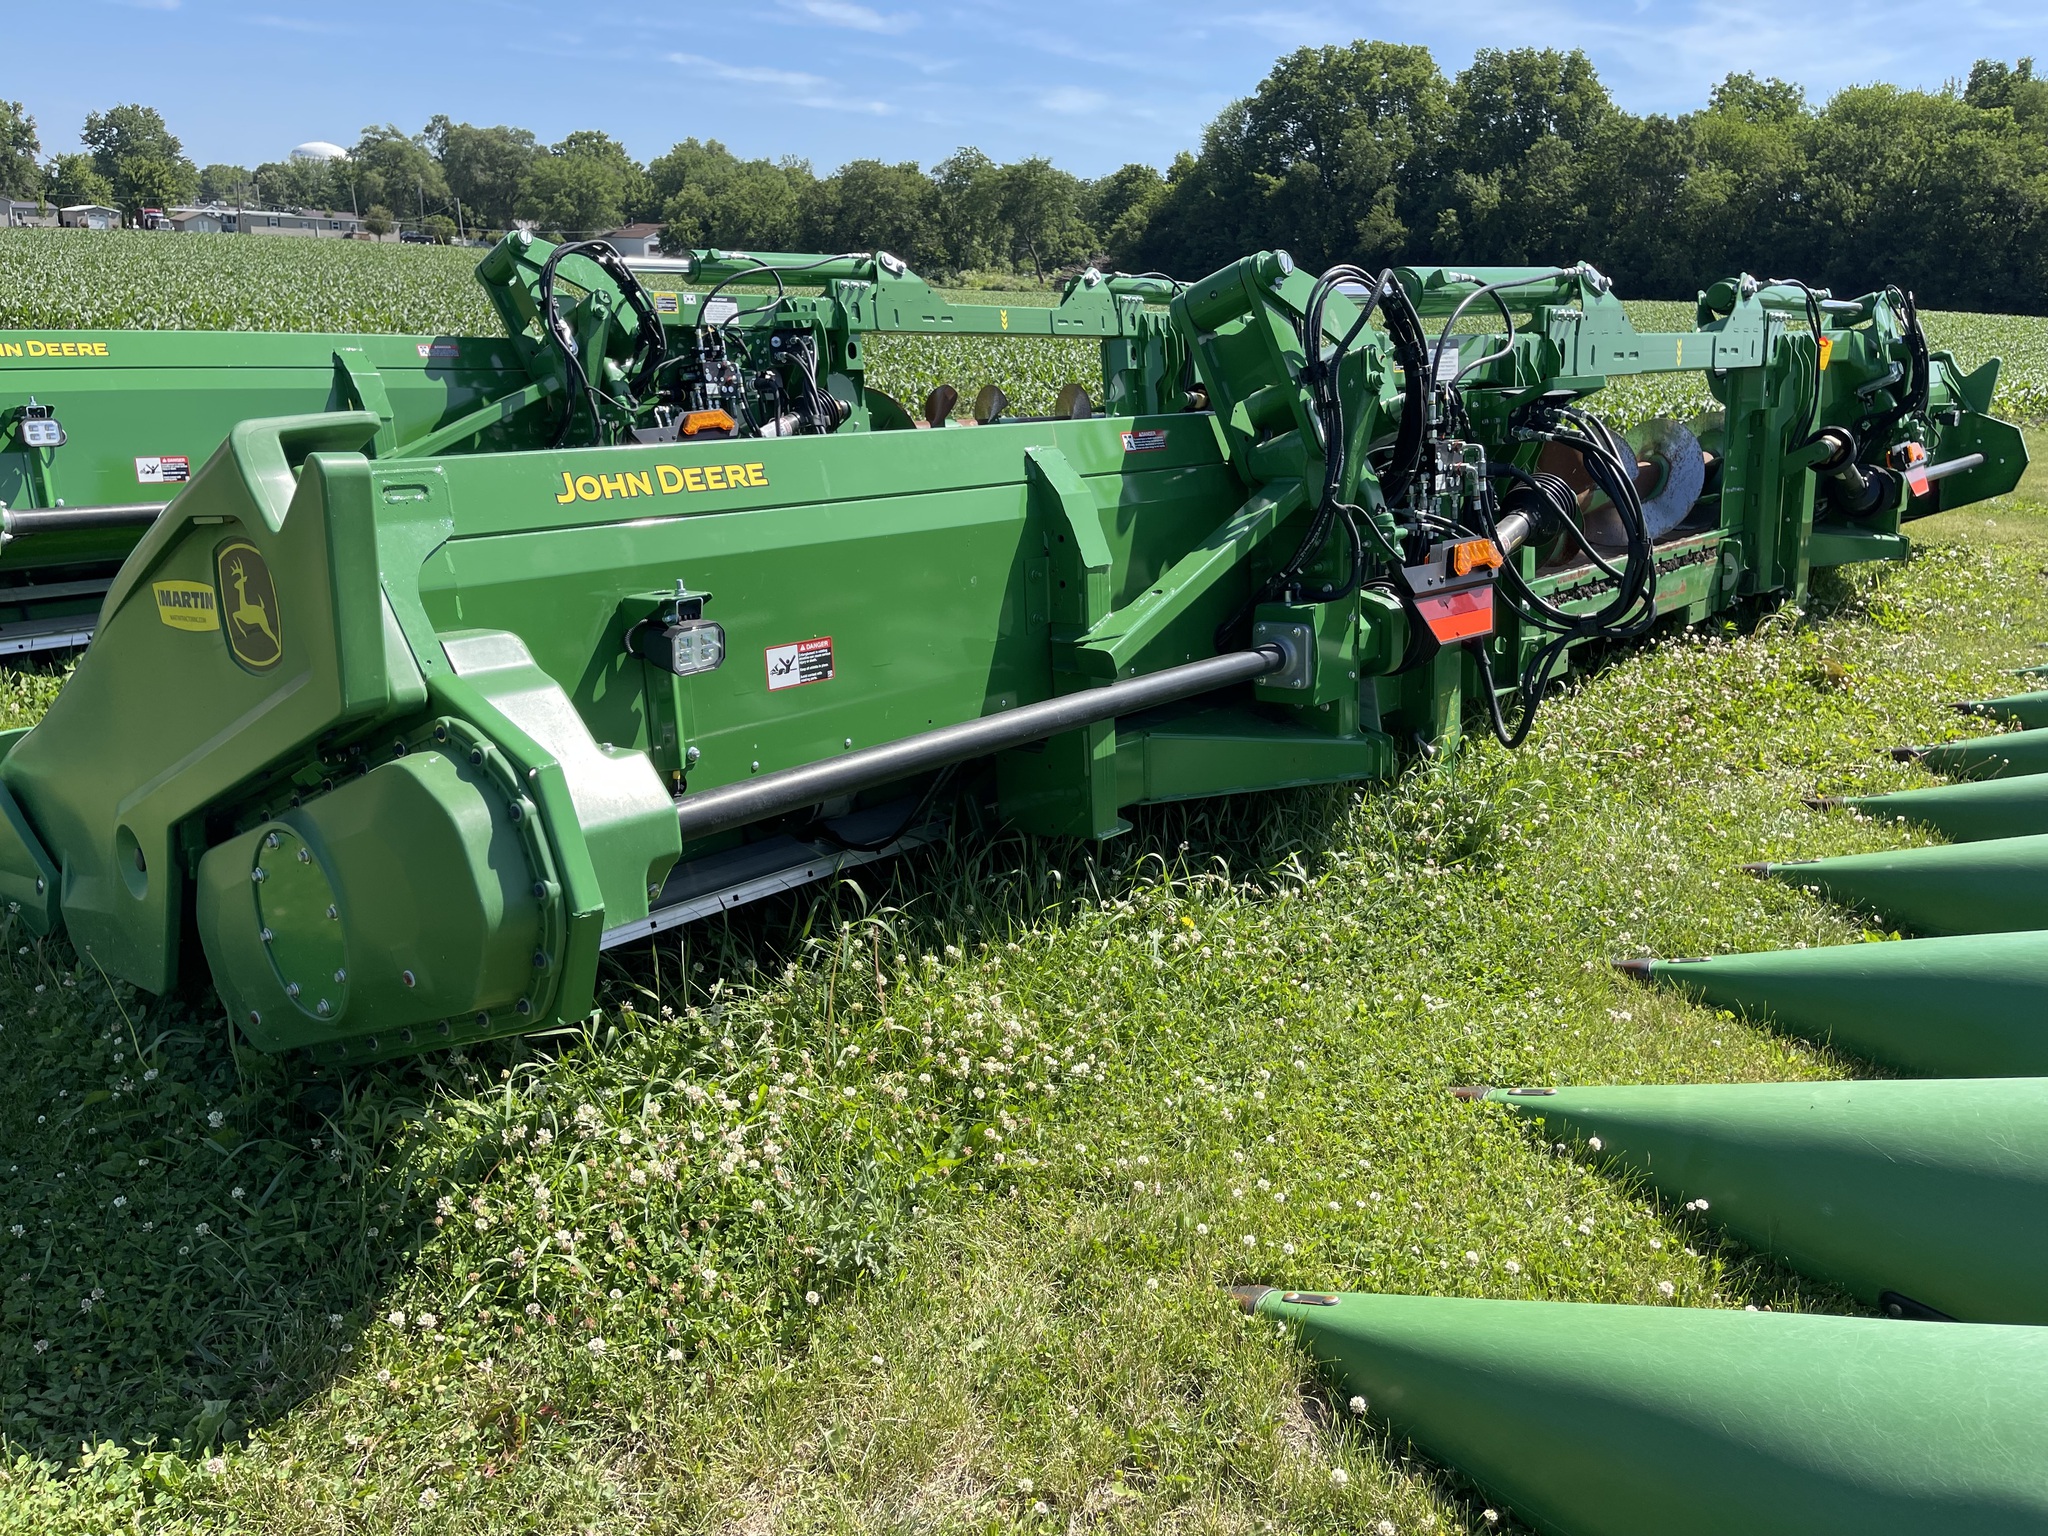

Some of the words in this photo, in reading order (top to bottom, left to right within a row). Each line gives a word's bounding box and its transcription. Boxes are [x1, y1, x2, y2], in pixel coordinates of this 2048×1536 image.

[25, 339, 110, 358] DEERE
[555, 470, 655, 505] JOHN
[654, 462, 770, 495] DEERE
[158, 589, 214, 610] MARTIN
[806, 640, 828, 650] DANGER
